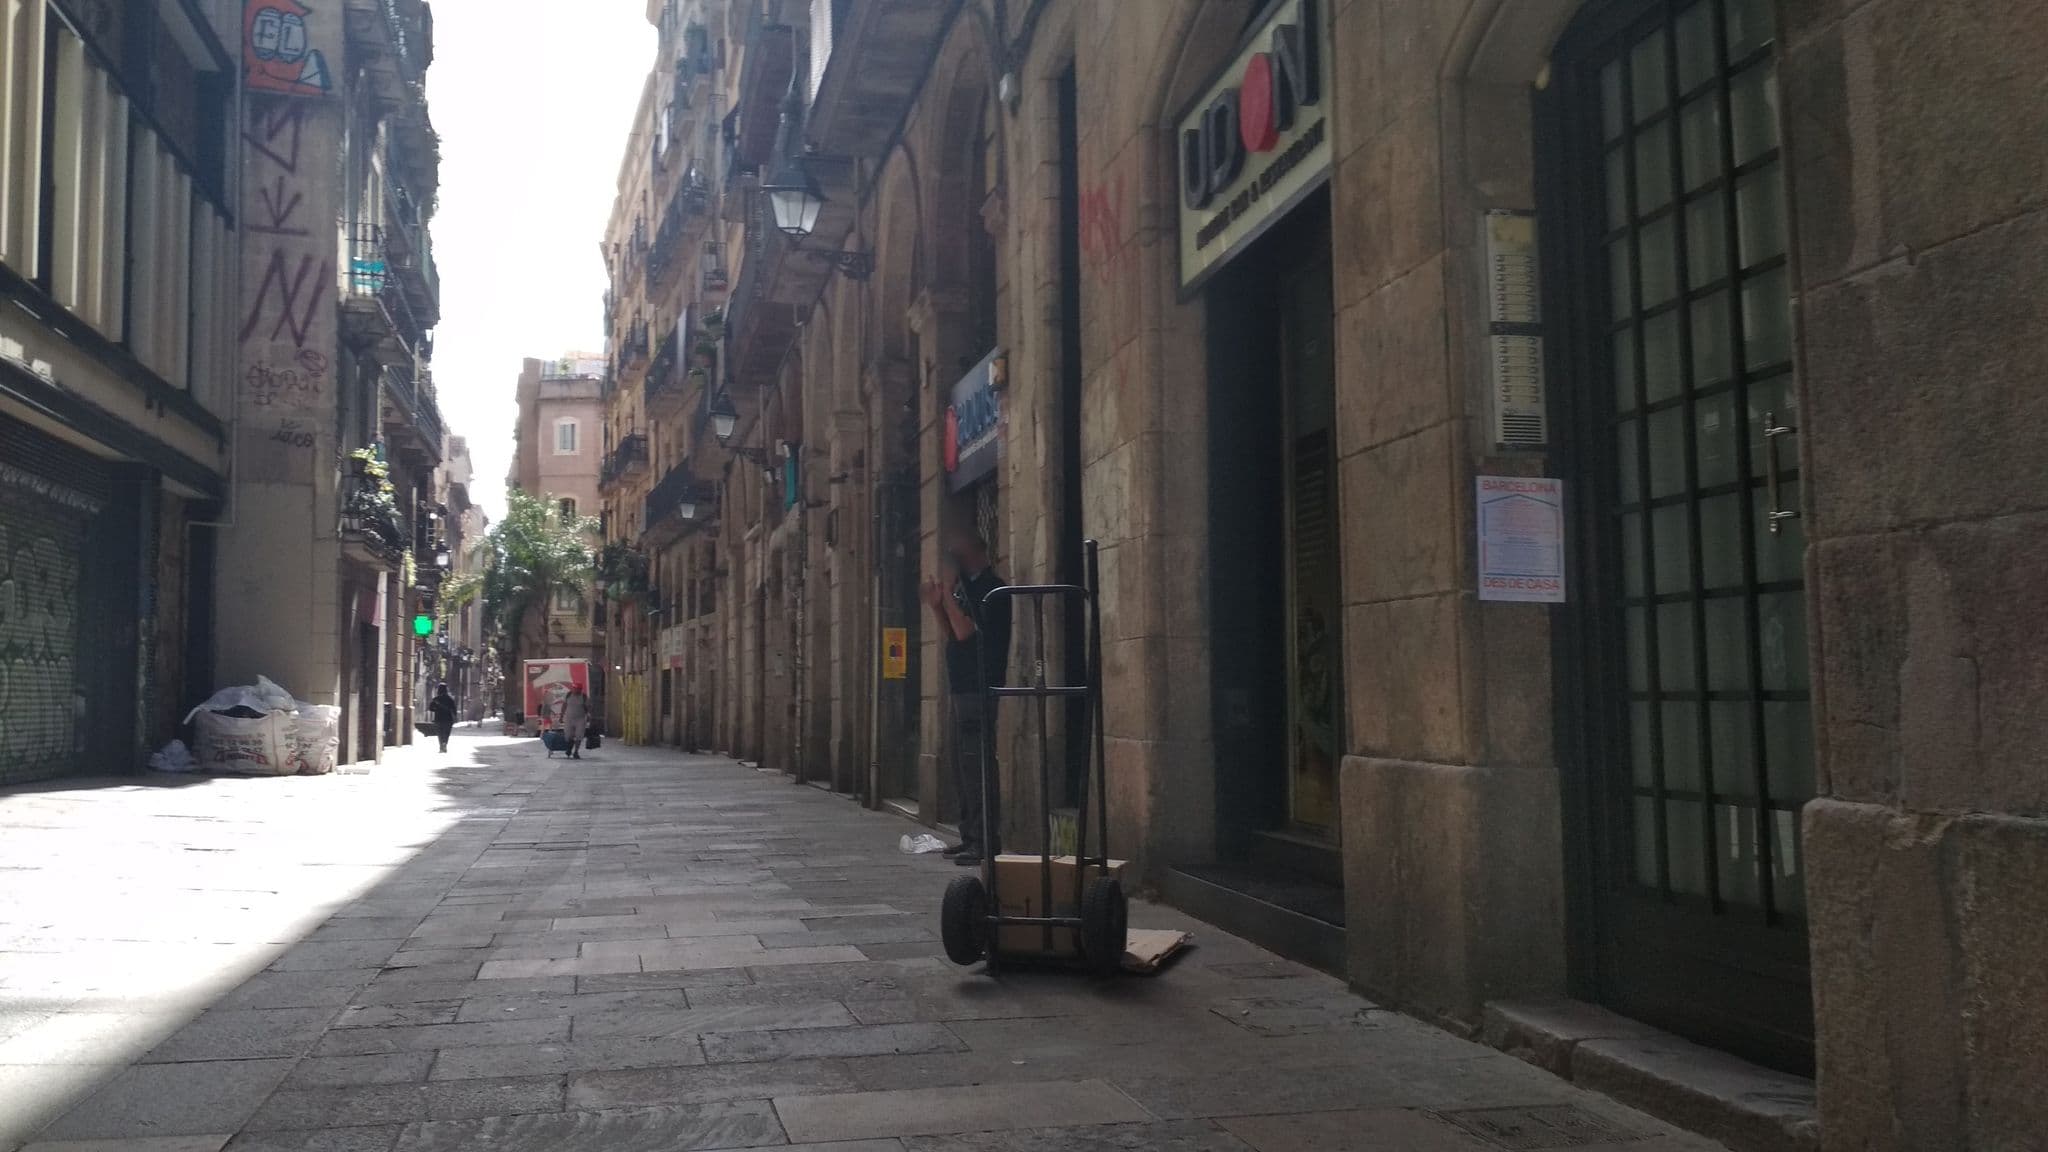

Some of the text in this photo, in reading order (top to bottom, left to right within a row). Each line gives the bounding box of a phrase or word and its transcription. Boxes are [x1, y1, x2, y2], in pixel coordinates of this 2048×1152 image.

[1184, 0, 1321, 210] UDON
[1482, 480, 1557, 494] BARCELONA
[1527, 579, 1560, 591] CASA
